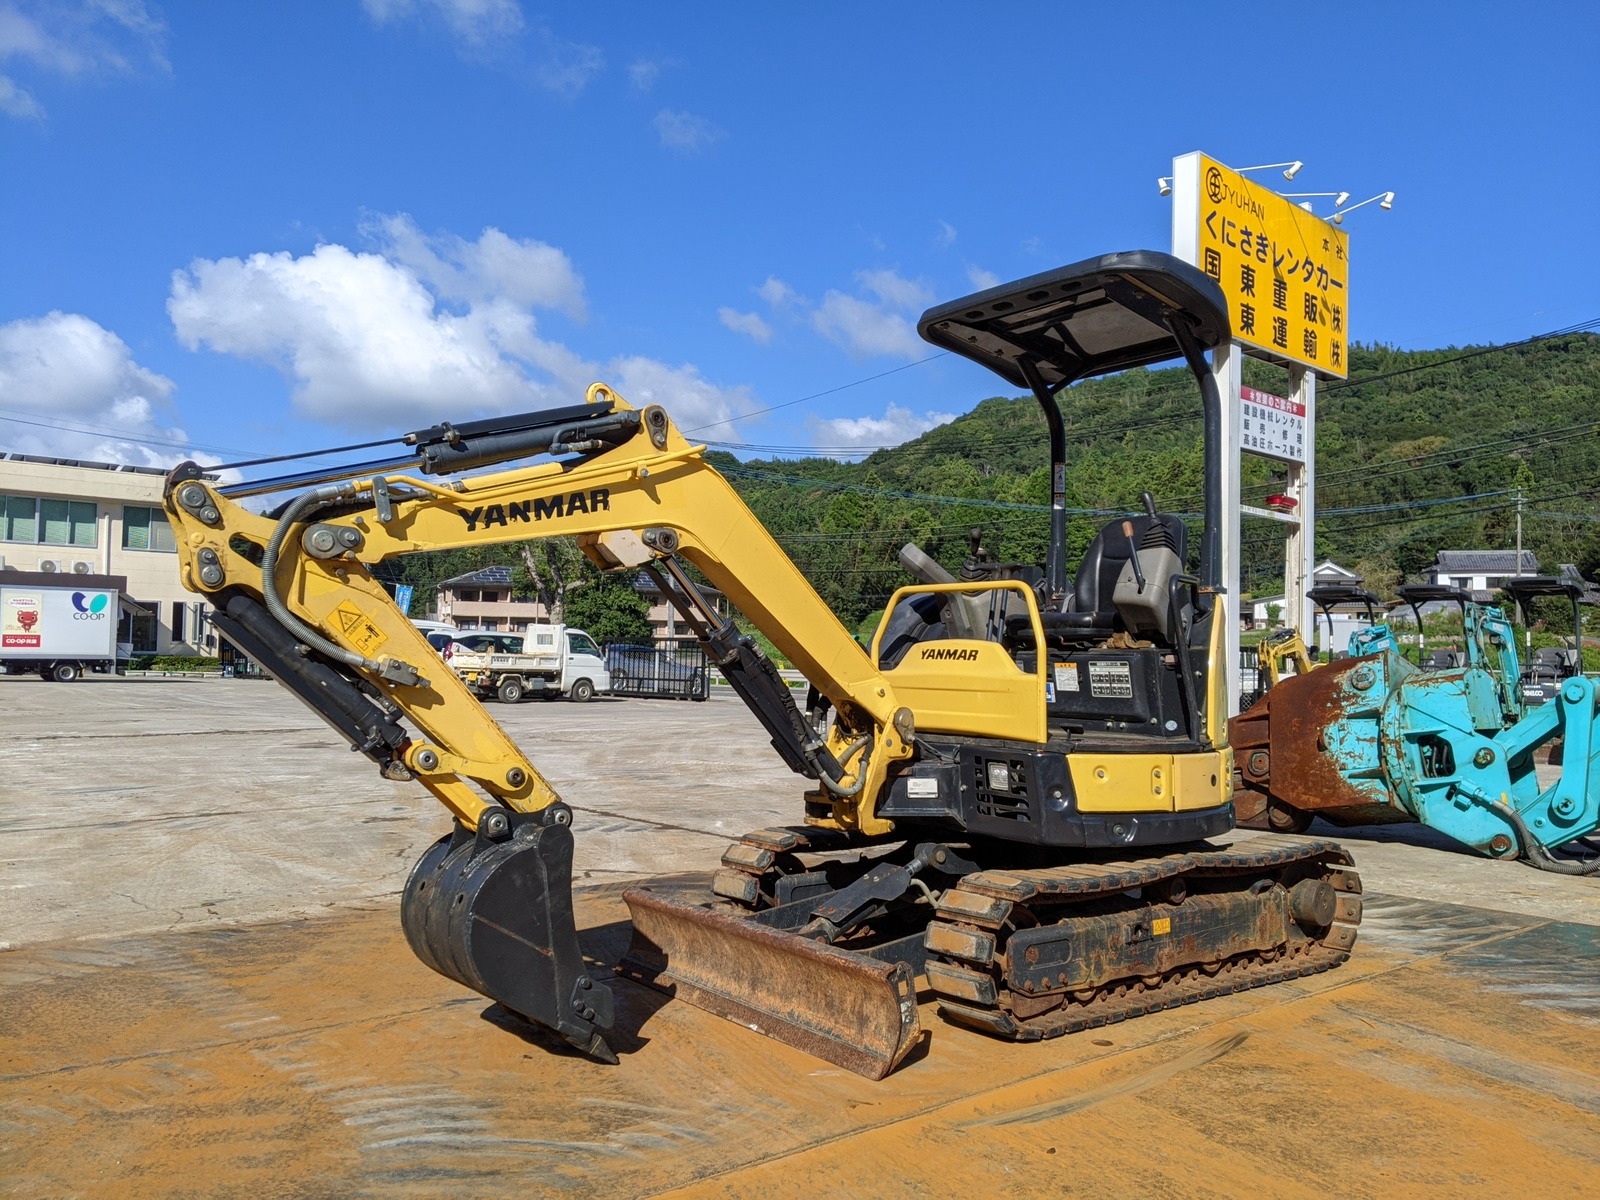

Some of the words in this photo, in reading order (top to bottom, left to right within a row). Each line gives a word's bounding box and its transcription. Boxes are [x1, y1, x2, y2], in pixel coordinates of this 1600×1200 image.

[1221, 183, 1265, 220] JYUHAN
[1206, 210, 1343, 292] くにさきレンタカー
[1322, 237, 1344, 260] 本社
[458, 488, 610, 532] YANMAR
[921, 648, 979, 661] YANMAR
